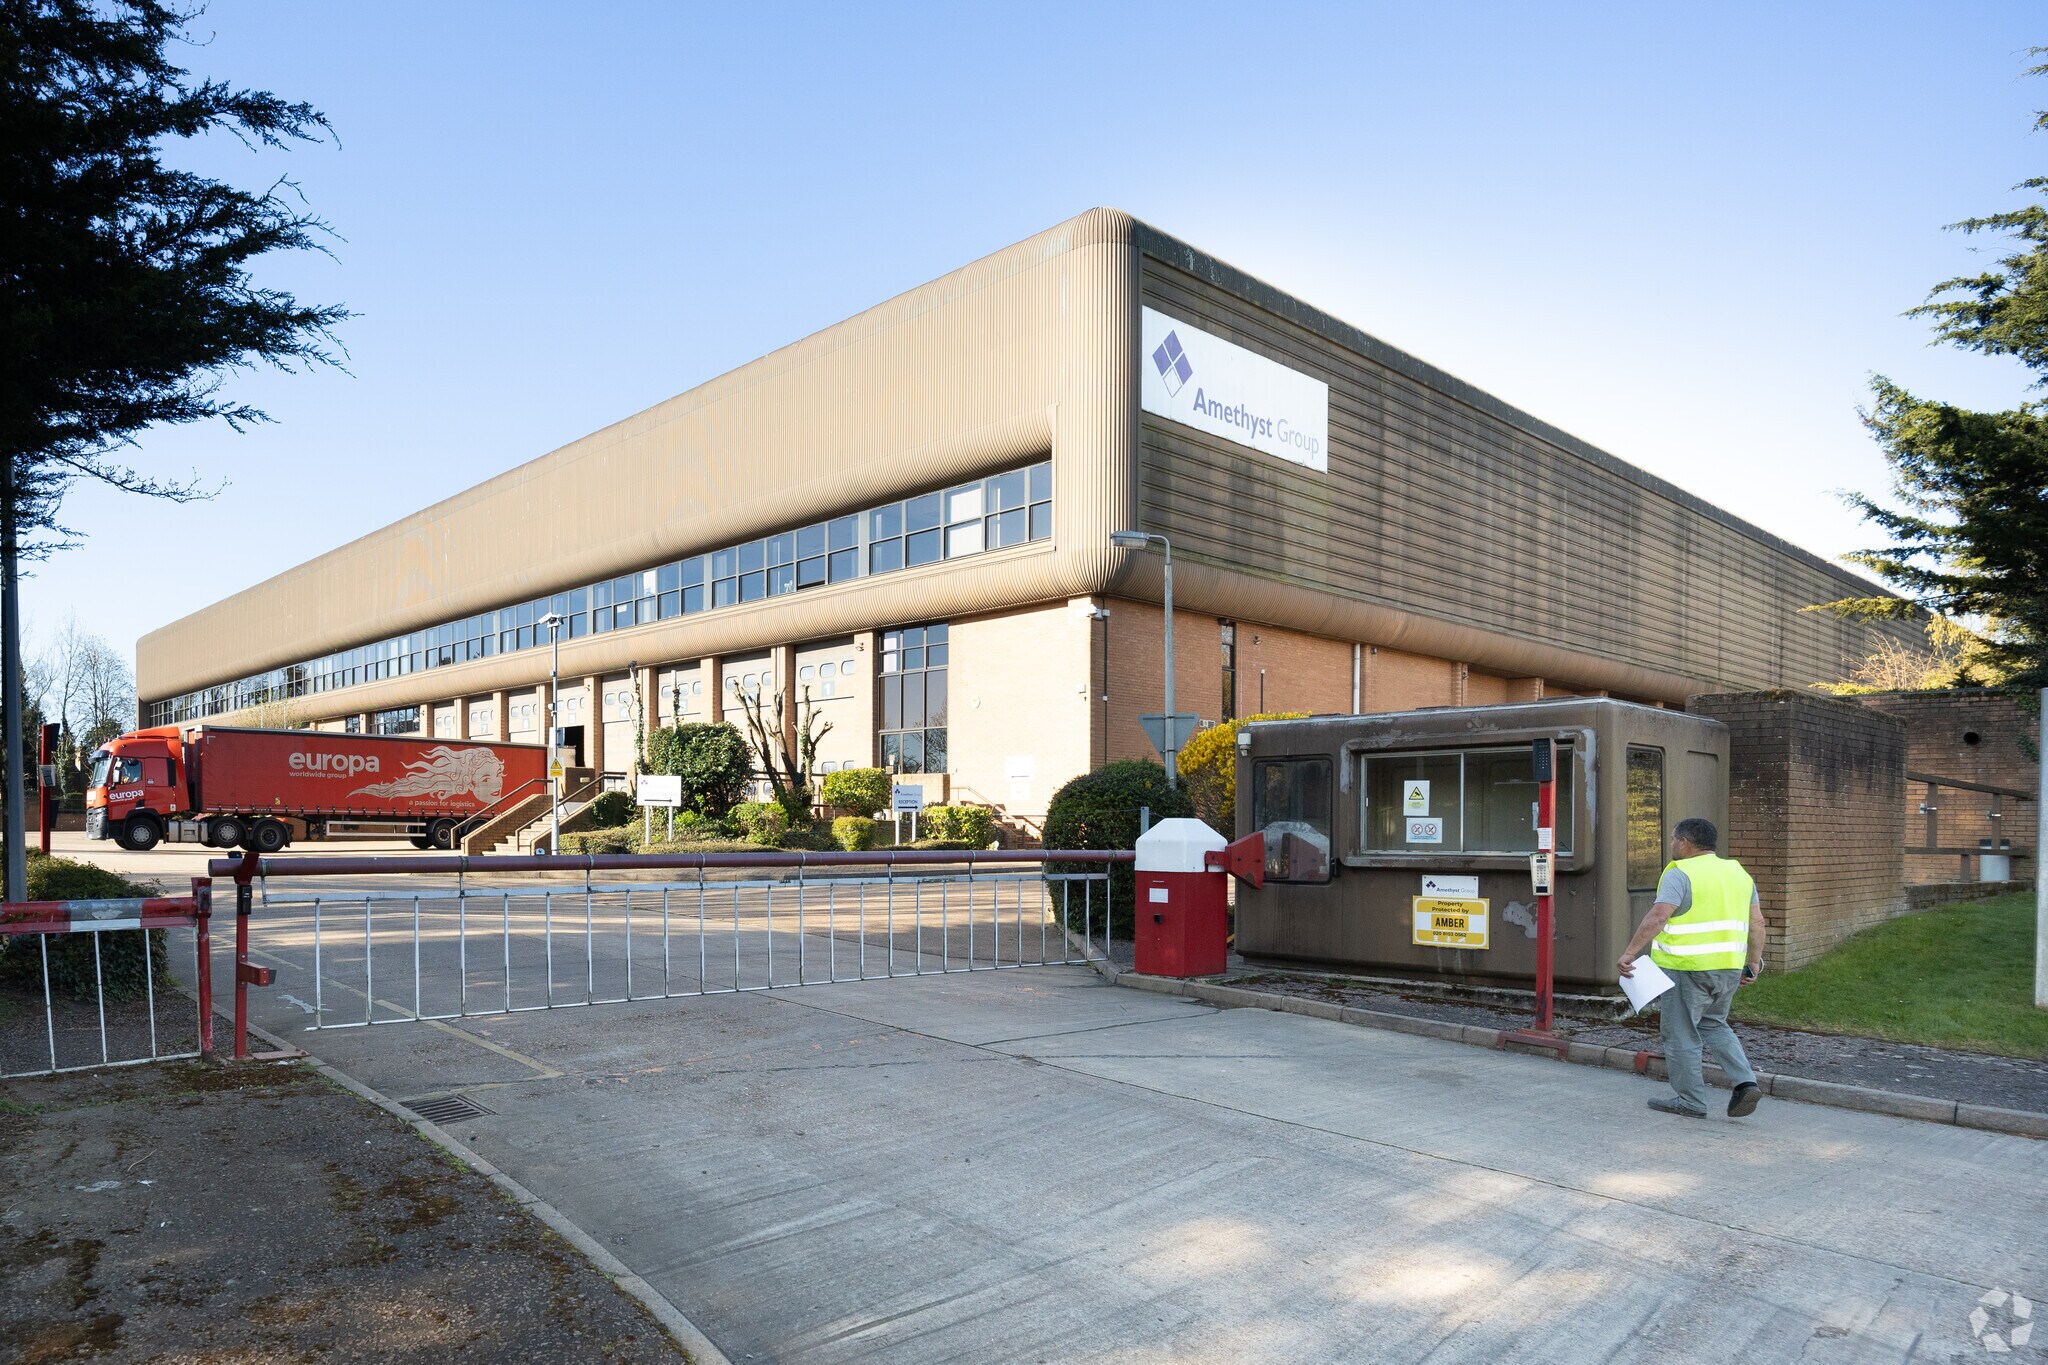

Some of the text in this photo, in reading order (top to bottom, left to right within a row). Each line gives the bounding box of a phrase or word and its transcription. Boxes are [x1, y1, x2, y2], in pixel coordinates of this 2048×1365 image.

[1193, 387, 1319, 460] Amethyst Group
[824, 683, 830, 695] 1
[289, 752, 380, 777] europa
[109, 789, 144, 800] europa
[450, 800, 475, 809] logistics
[1435, 917, 1465, 928] AMBER
